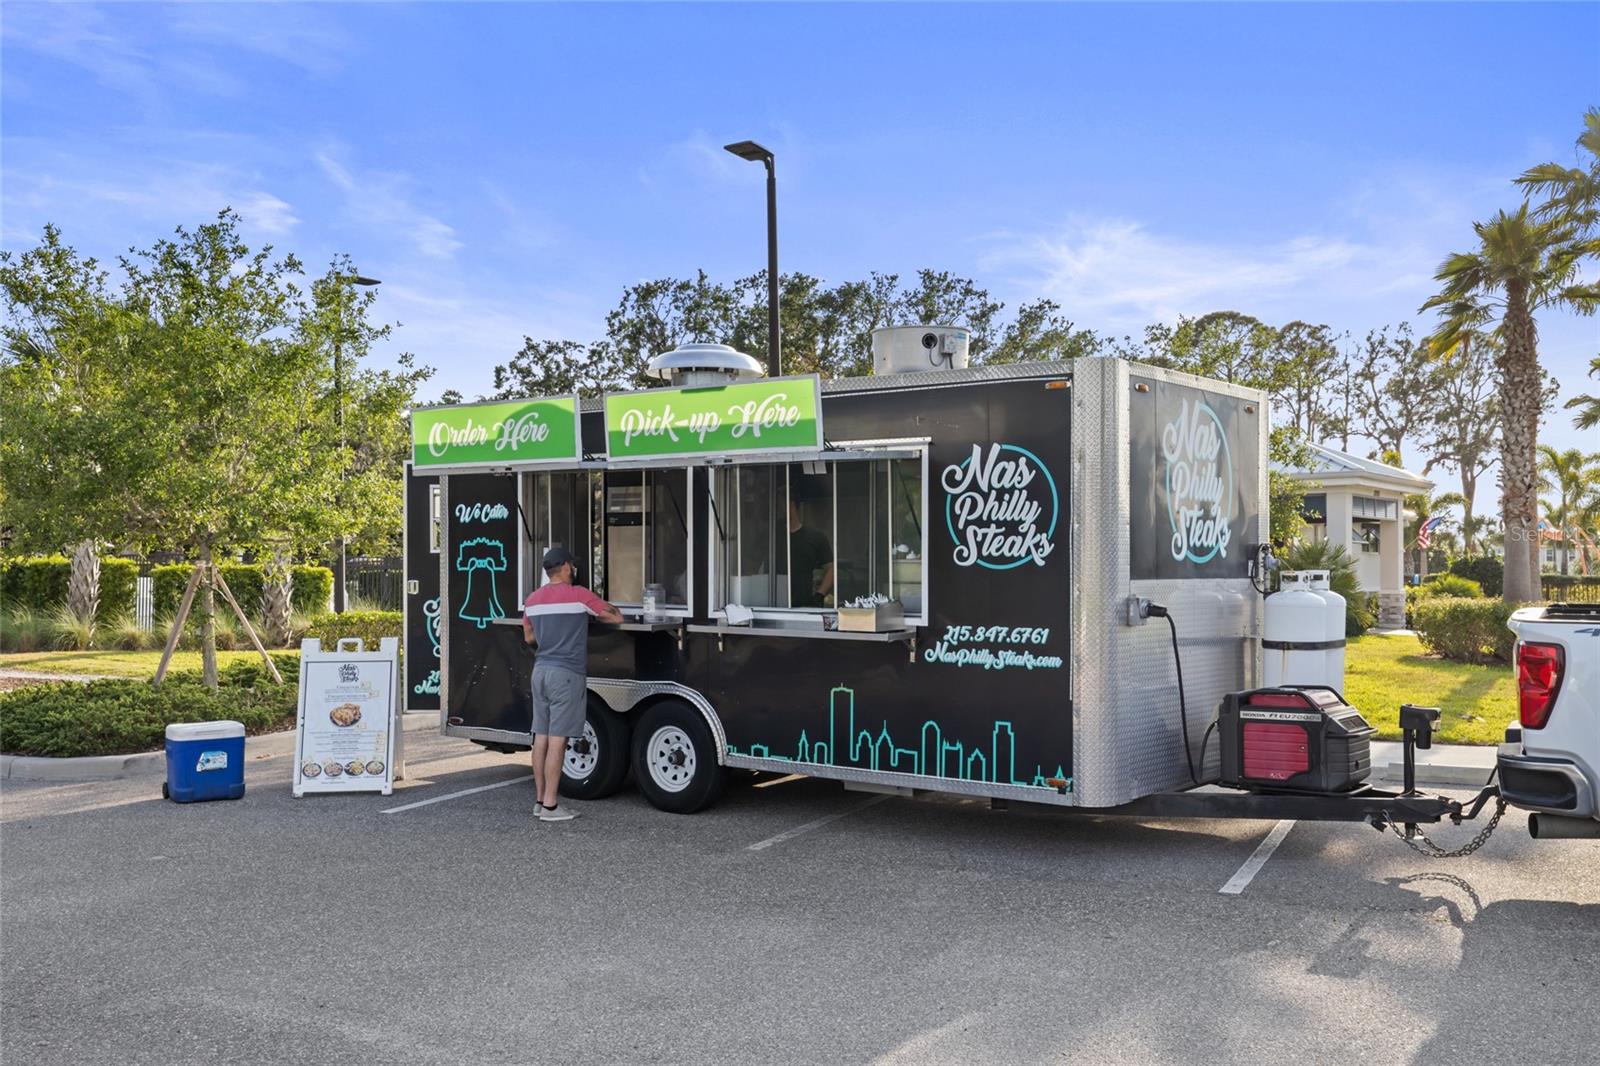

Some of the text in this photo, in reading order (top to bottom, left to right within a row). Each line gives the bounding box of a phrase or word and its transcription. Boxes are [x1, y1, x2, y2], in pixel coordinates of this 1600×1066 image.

[428, 412, 550, 457] Order Here
[620, 393, 801, 447] Pick-up Here
[1162, 397, 1221, 464] Nas
[941, 442, 1036, 494] Nas
[1171, 462, 1225, 517] Philly
[455, 503, 509, 523] We Cater
[954, 489, 1042, 533] Philly
[1171, 505, 1232, 562] Steaks
[953, 523, 1055, 567] Steaks
[942, 625, 1050, 646] 215.847.6761
